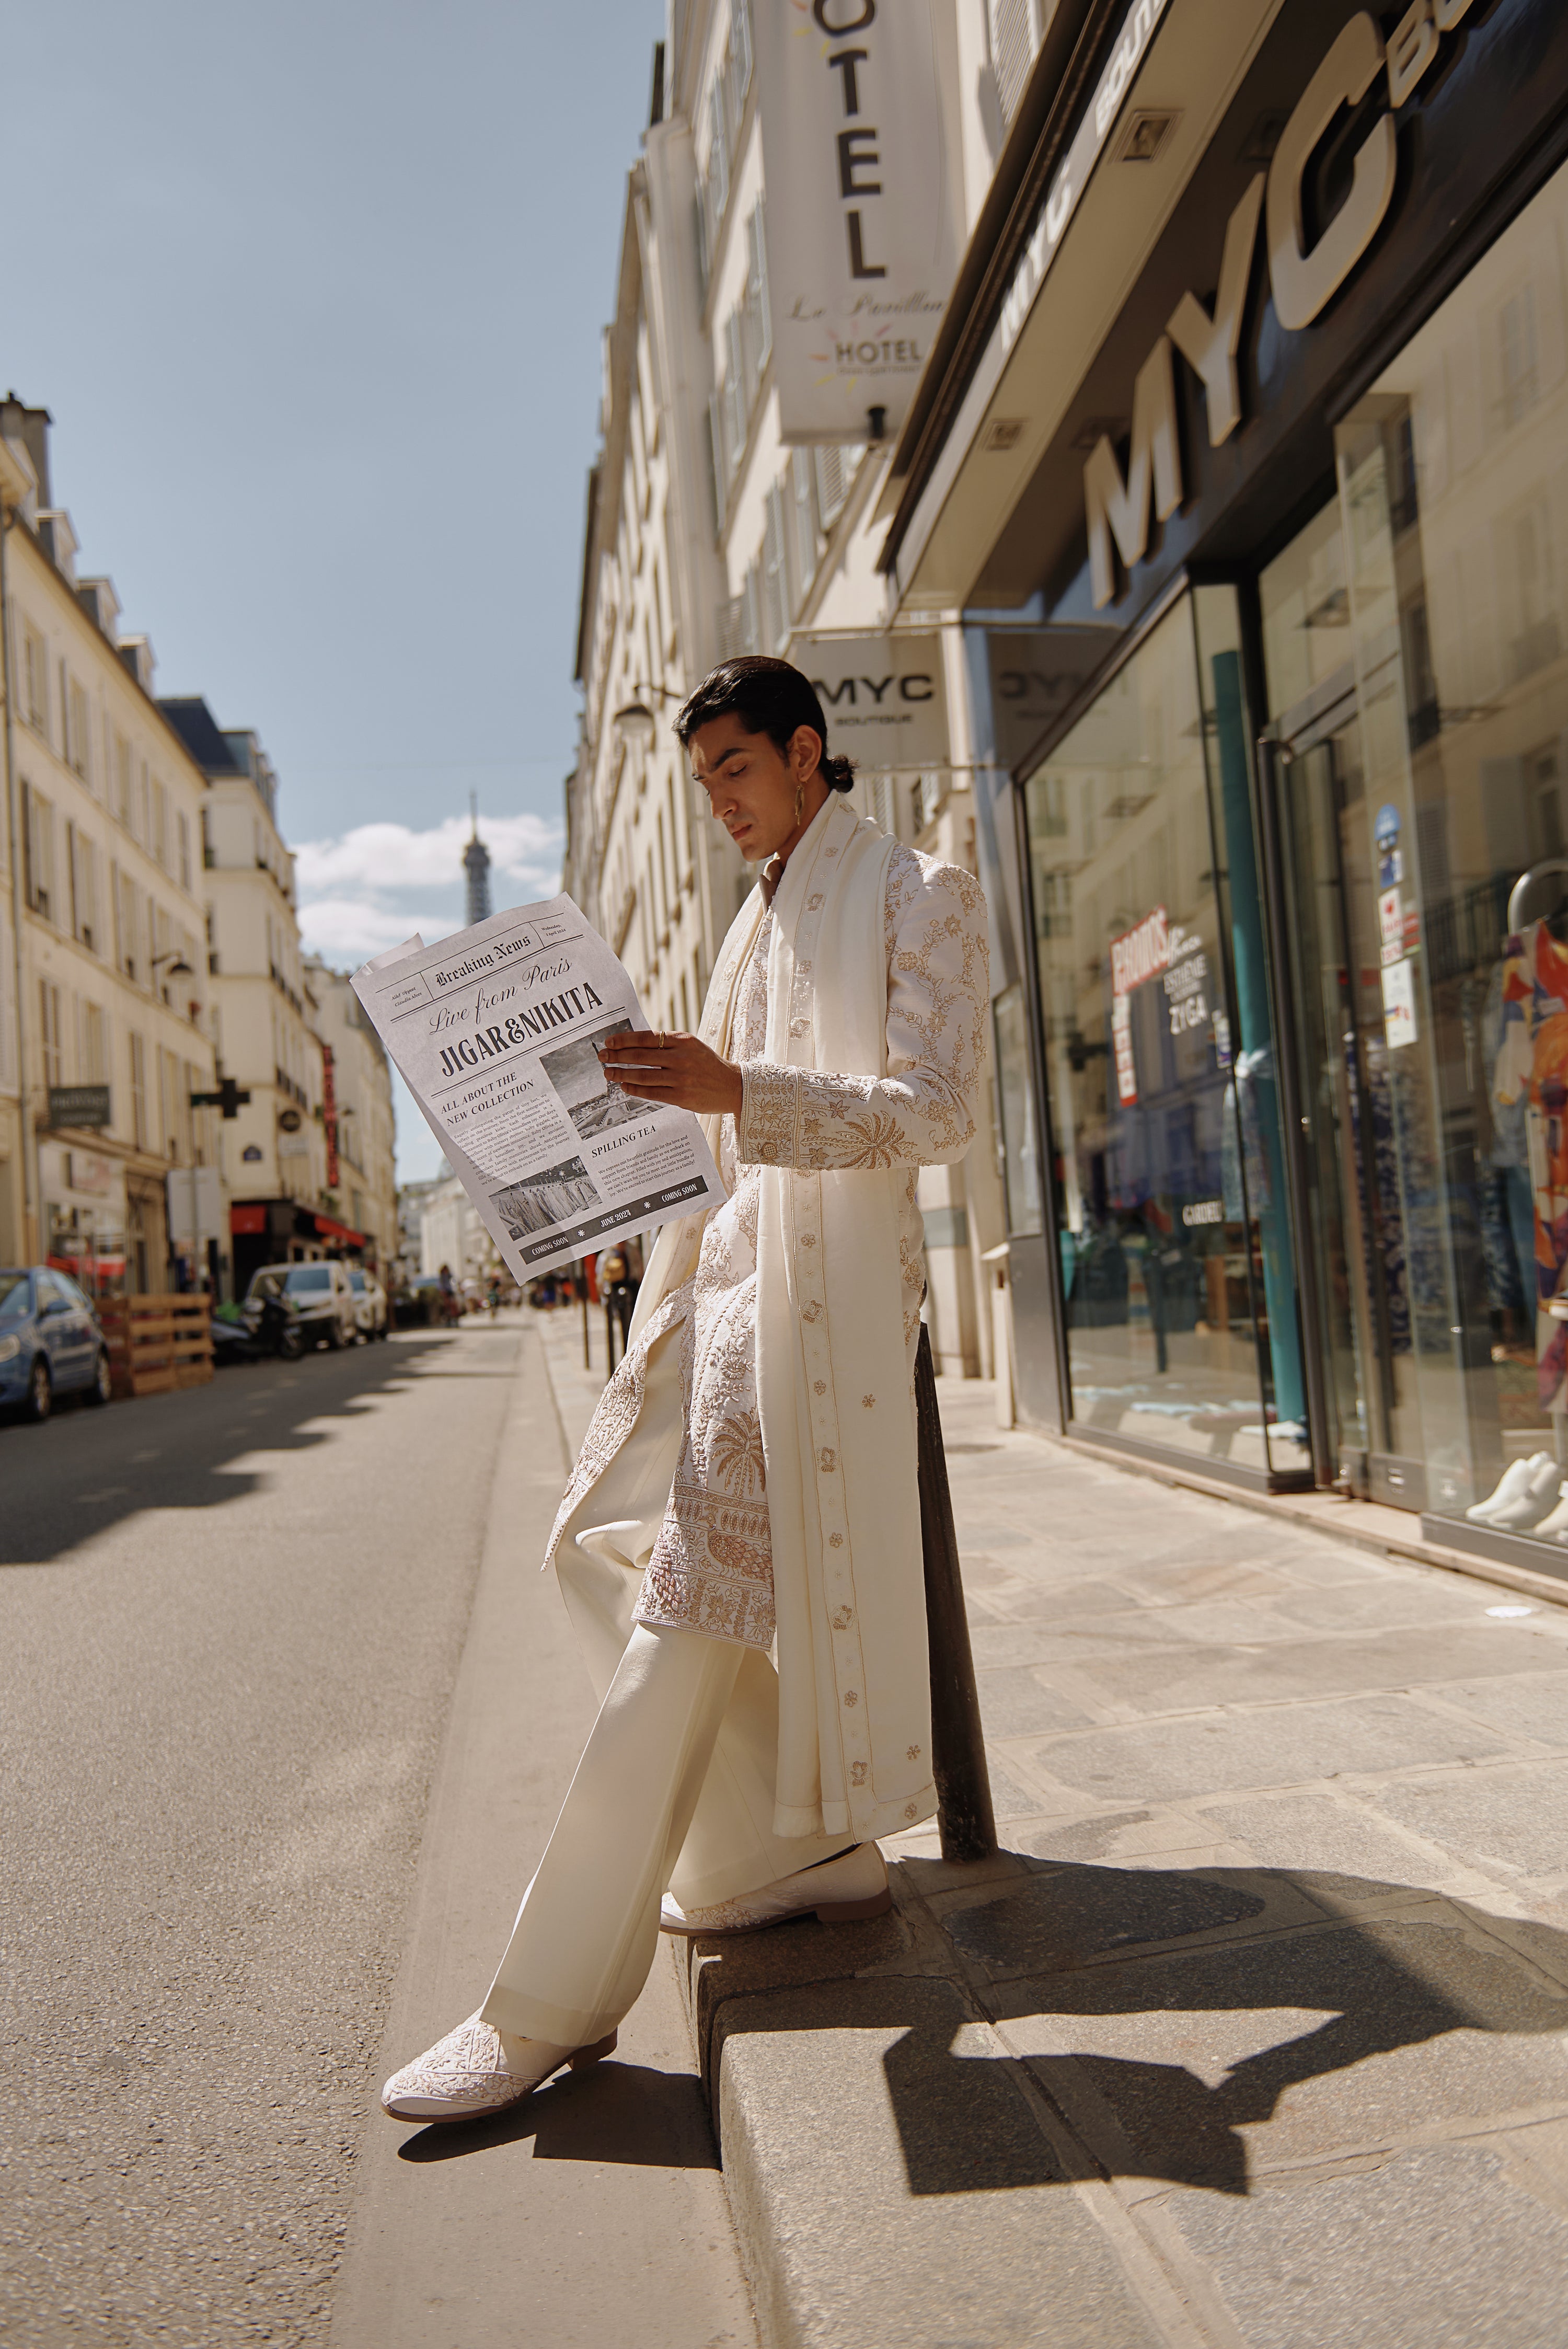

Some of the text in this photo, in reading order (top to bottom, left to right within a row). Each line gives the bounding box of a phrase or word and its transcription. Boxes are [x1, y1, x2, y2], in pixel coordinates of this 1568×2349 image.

[1084, 9, 1398, 609] MYC
[836, 340, 923, 363] HOTEL
[812, 674, 933, 705] MYC
[834, 713, 914, 727] BOUTIQUE
[436, 937, 531, 986] Breaking News
[395, 997, 411, 1007] Claudia
[430, 958, 572, 1035] Live from Paris
[439, 982, 603, 1077] JIGAR&NIKITA
[442, 1073, 516, 1113] ALL ABOUT THE
[447, 1079, 533, 1126] NEW COLLECTION
[460, 1141, 474, 1150] feeling
[477, 1132, 492, 1142] precious
[522, 1110, 540, 1120] milestone
[471, 1120, 493, 1131] anticipating
[483, 1123, 499, 1132] journey,
[526, 1102, 545, 1111] sonogram
[463, 1144, 482, 1154] testament
[511, 1121, 531, 1131] boundless
[476, 1165, 493, 1174] countless
[509, 1150, 528, 1159] memories
[545, 1131, 567, 1144] Anticipation
[493, 1144, 510, 1153] newborn
[510, 1135, 531, 1145] innocence.
[495, 1149, 515, 1158] boundless
[548, 1126, 564, 1134] envision
[519, 1151, 539, 1161] excitement
[555, 1137, 569, 1146] journey
[592, 1125, 655, 1157] SPILLING TEA
[465, 1149, 482, 1159] overflow
[627, 1154, 642, 1162] heartfelt
[643, 1147, 659, 1156] gratitude
[670, 1149, 692, 1159] anticipation,
[662, 1183, 697, 1202] COMING SOON
[601, 1210, 631, 1227] JUNE 2024
[532, 1237, 568, 1255] COMING SOON
